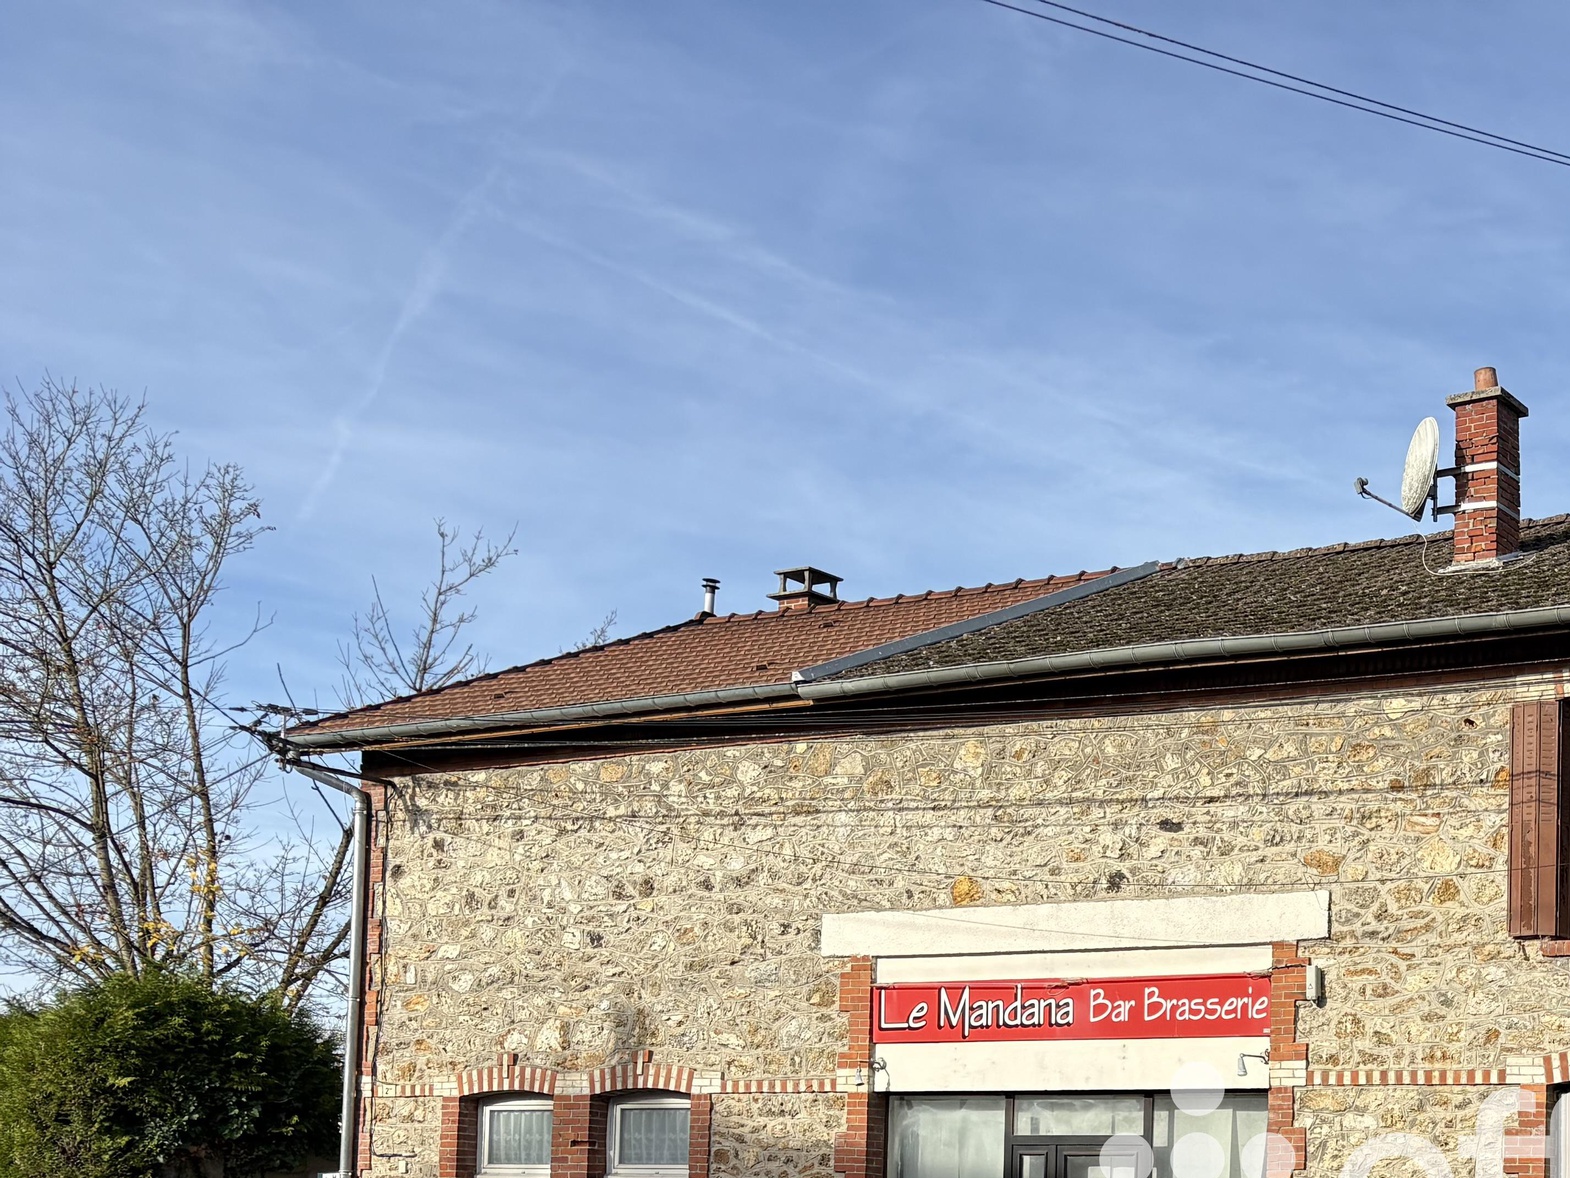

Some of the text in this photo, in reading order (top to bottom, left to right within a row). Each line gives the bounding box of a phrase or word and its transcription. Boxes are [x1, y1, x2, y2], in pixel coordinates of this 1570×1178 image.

[880, 984, 1269, 1039] Le Mandana Bar Brasserie
